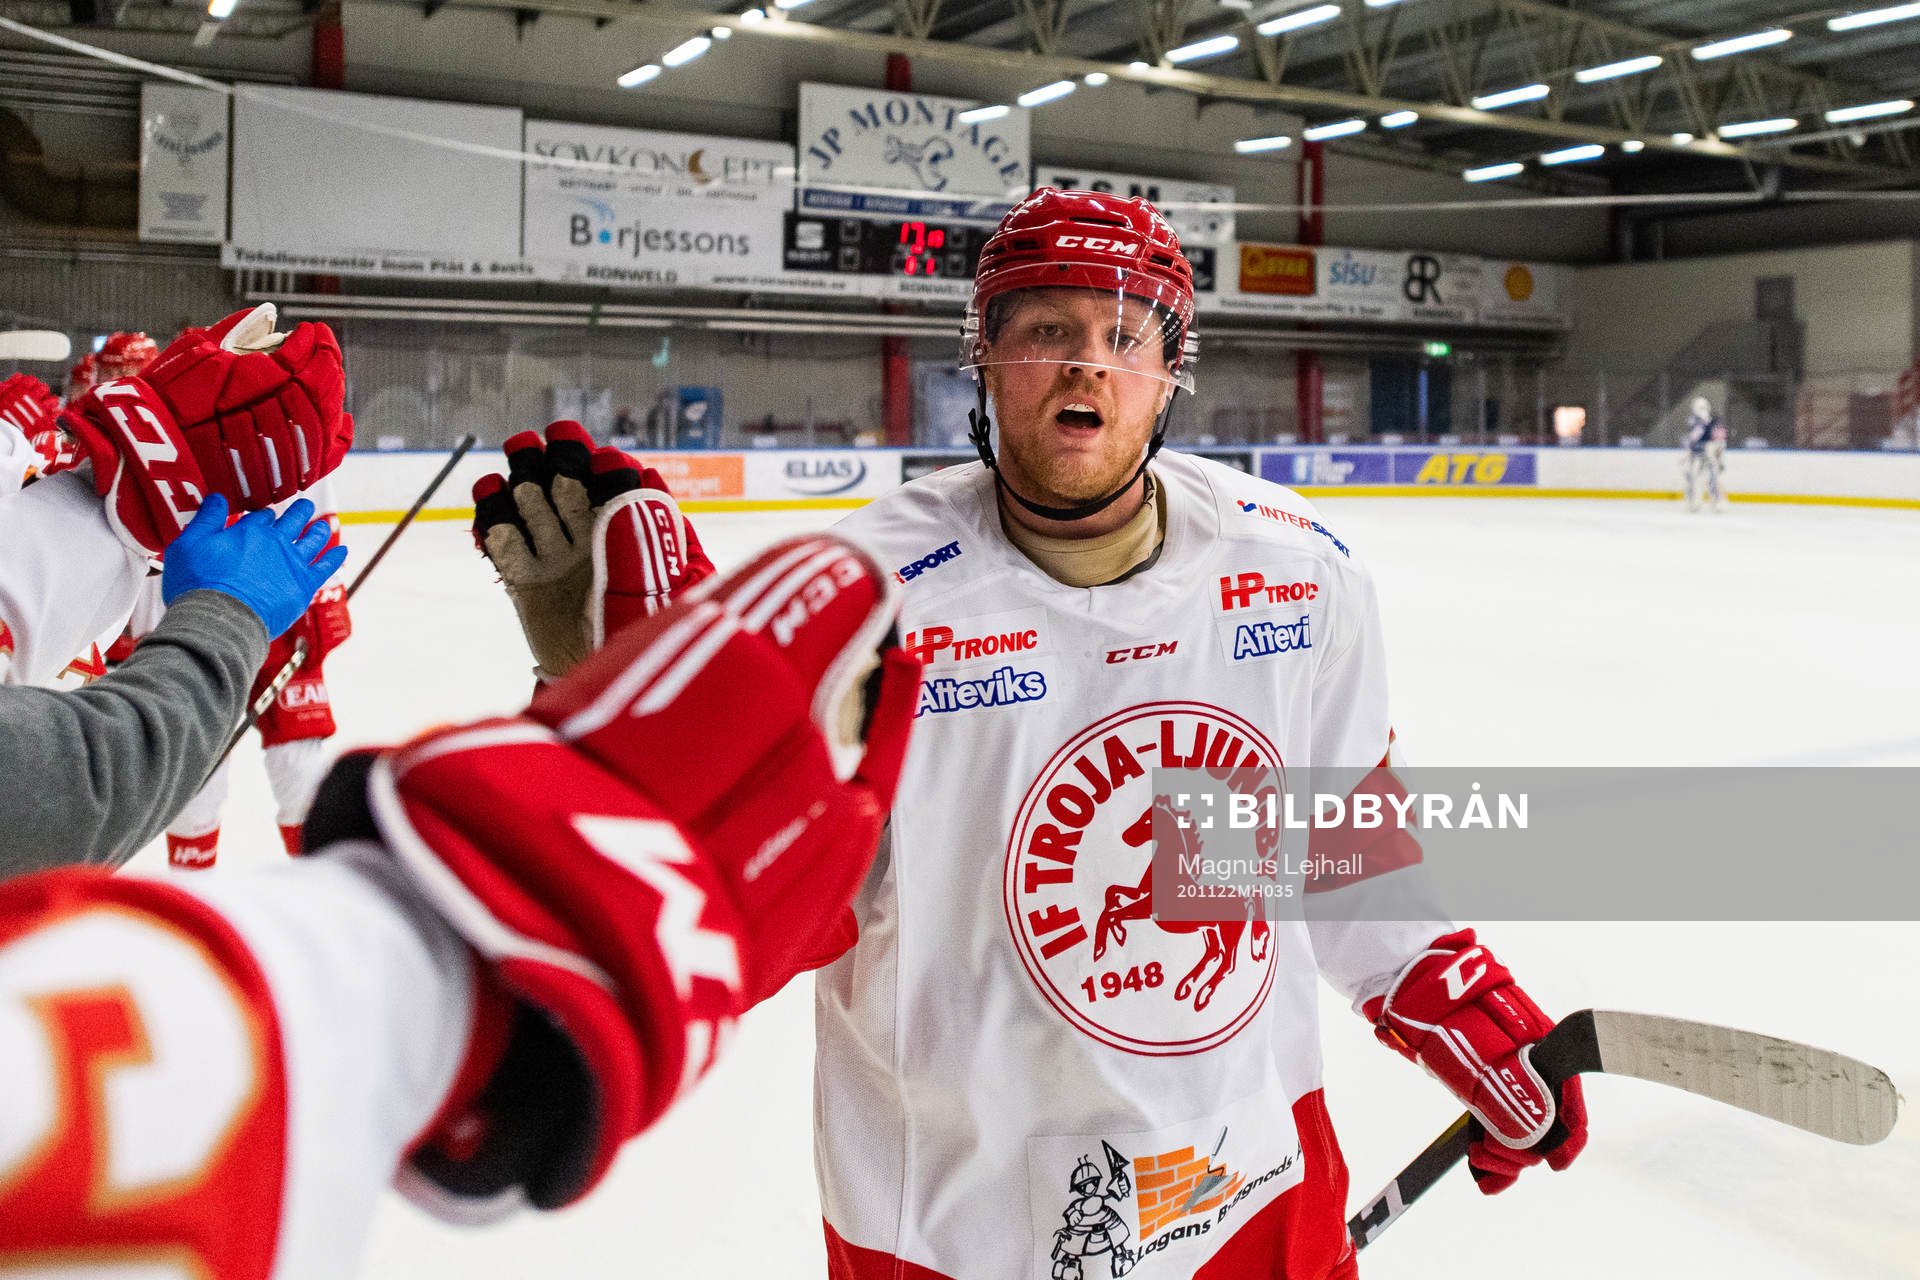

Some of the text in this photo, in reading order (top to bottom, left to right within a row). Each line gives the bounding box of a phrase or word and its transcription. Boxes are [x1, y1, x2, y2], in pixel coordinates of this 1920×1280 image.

[808, 127, 843, 170] JP
[1055, 234, 1139, 256] CCM
[785, 459, 841, 480] ELIAS
[1416, 453, 1510, 487] ATG
[653, 508, 681, 577] CCM
[1259, 504, 1351, 559] INTERSPORT
[1105, 640, 1179, 665] CCM
[1233, 615, 1313, 660] Attevi
[913, 665, 1047, 719] Atteviks
[1028, 904, 1088, 961] IF
[1080, 961, 1165, 1003] 1948
[1500, 1067, 1543, 1117] CCM
[1136, 1219, 1212, 1263] Lagans
[1217, 1155, 1293, 1224] Bggnads
